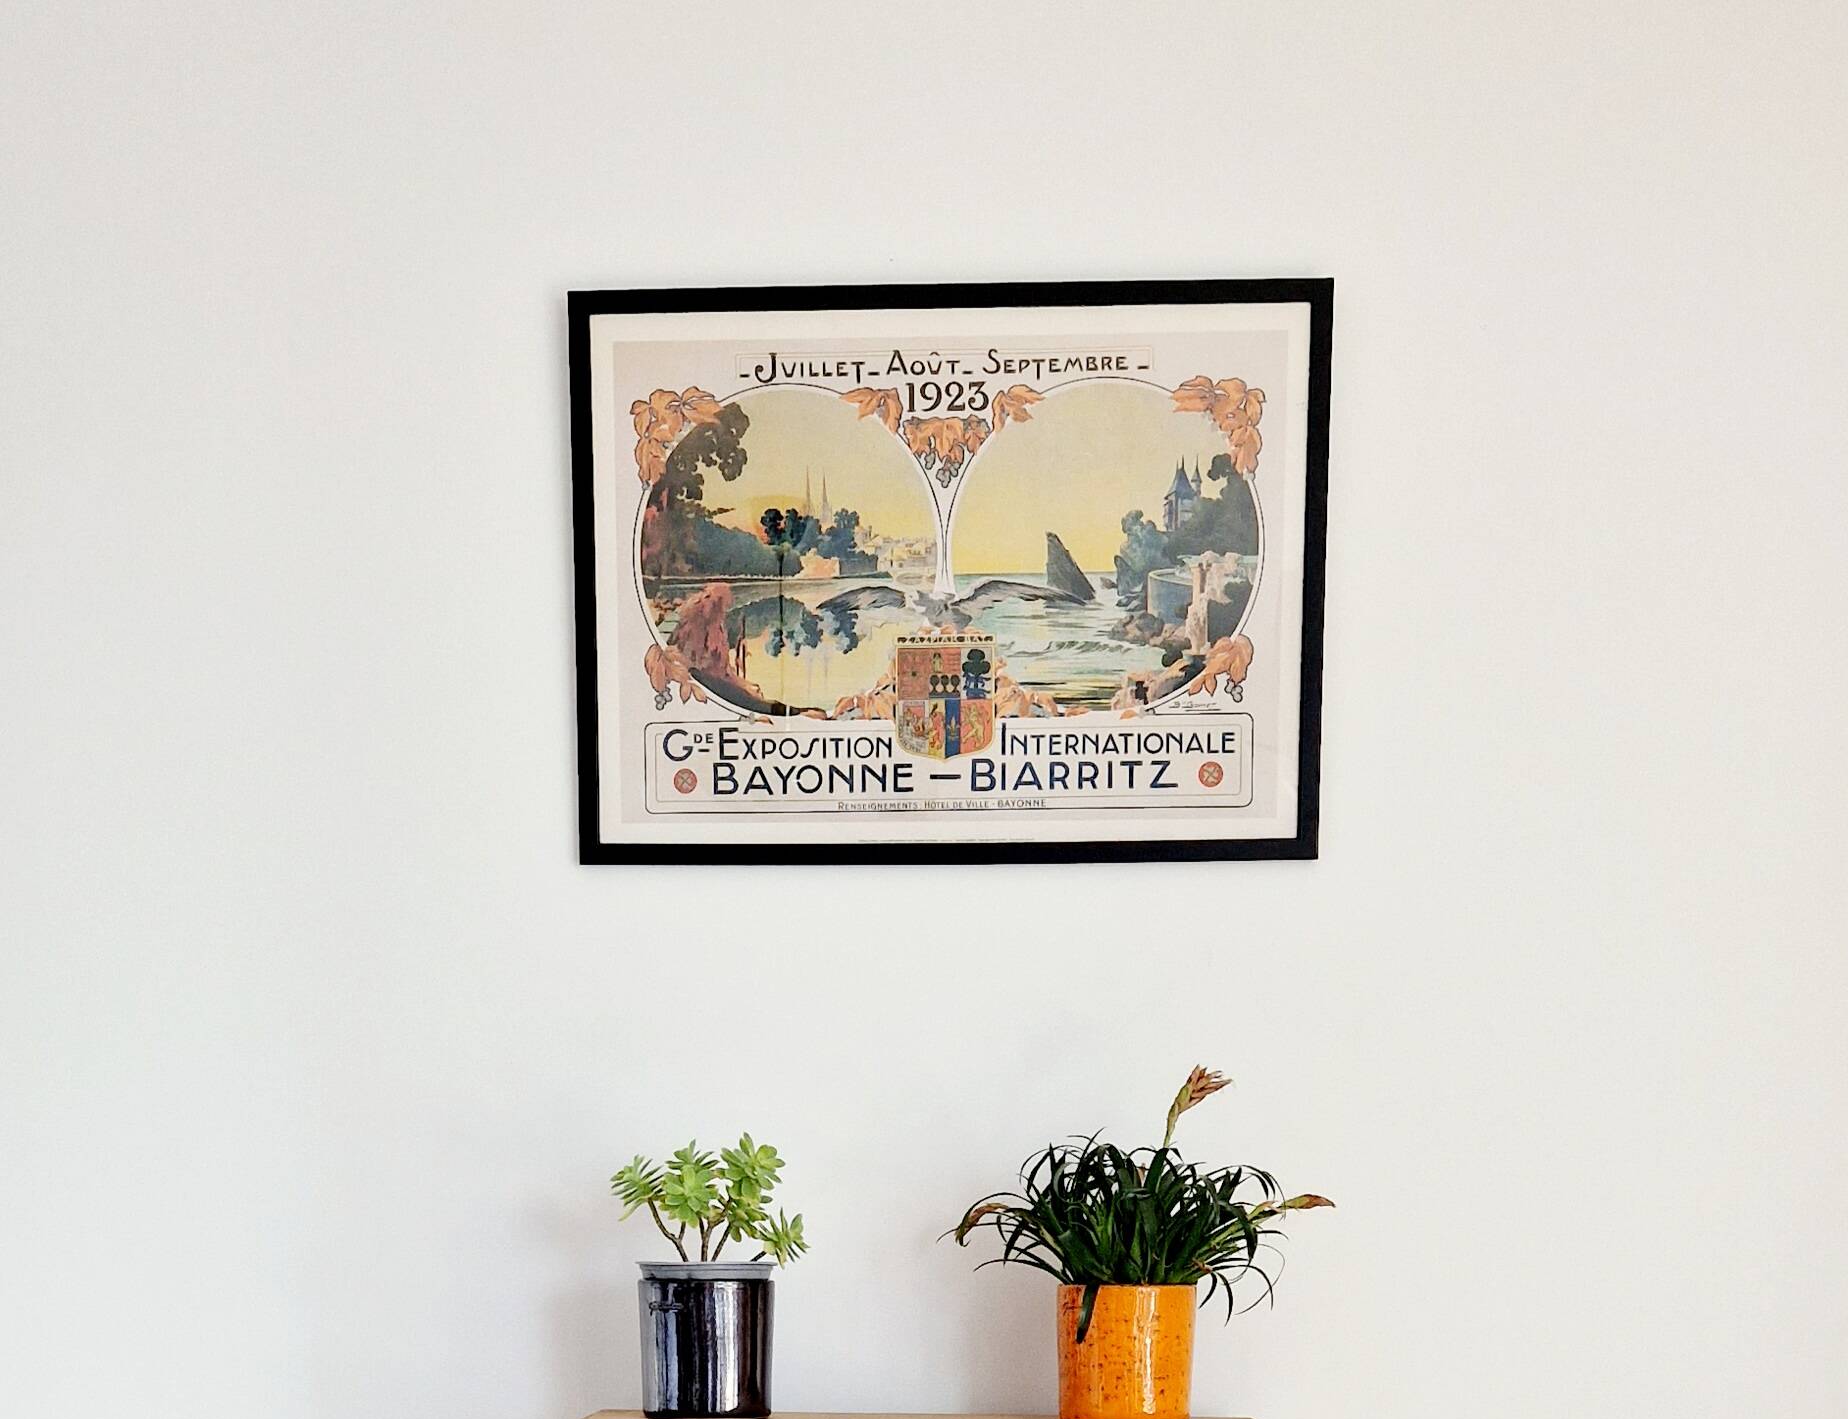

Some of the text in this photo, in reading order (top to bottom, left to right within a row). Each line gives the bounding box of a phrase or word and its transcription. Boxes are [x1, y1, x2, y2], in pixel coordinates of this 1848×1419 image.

[886, 350, 961, 376] AOÛT
[983, 348, 1129, 380] SEPTEMBRE
[905, 381, 990, 412] 1923
[719, 727, 892, 760] EXPOSITION
[1001, 722, 1236, 756] INTERNATIONALE
[713, 758, 1178, 795] BAYONNE BIARRITZ
[952, 801, 963, 809] DE
[966, 799, 990, 809] VILLE
[998, 798, 1047, 808] BAYONNE
